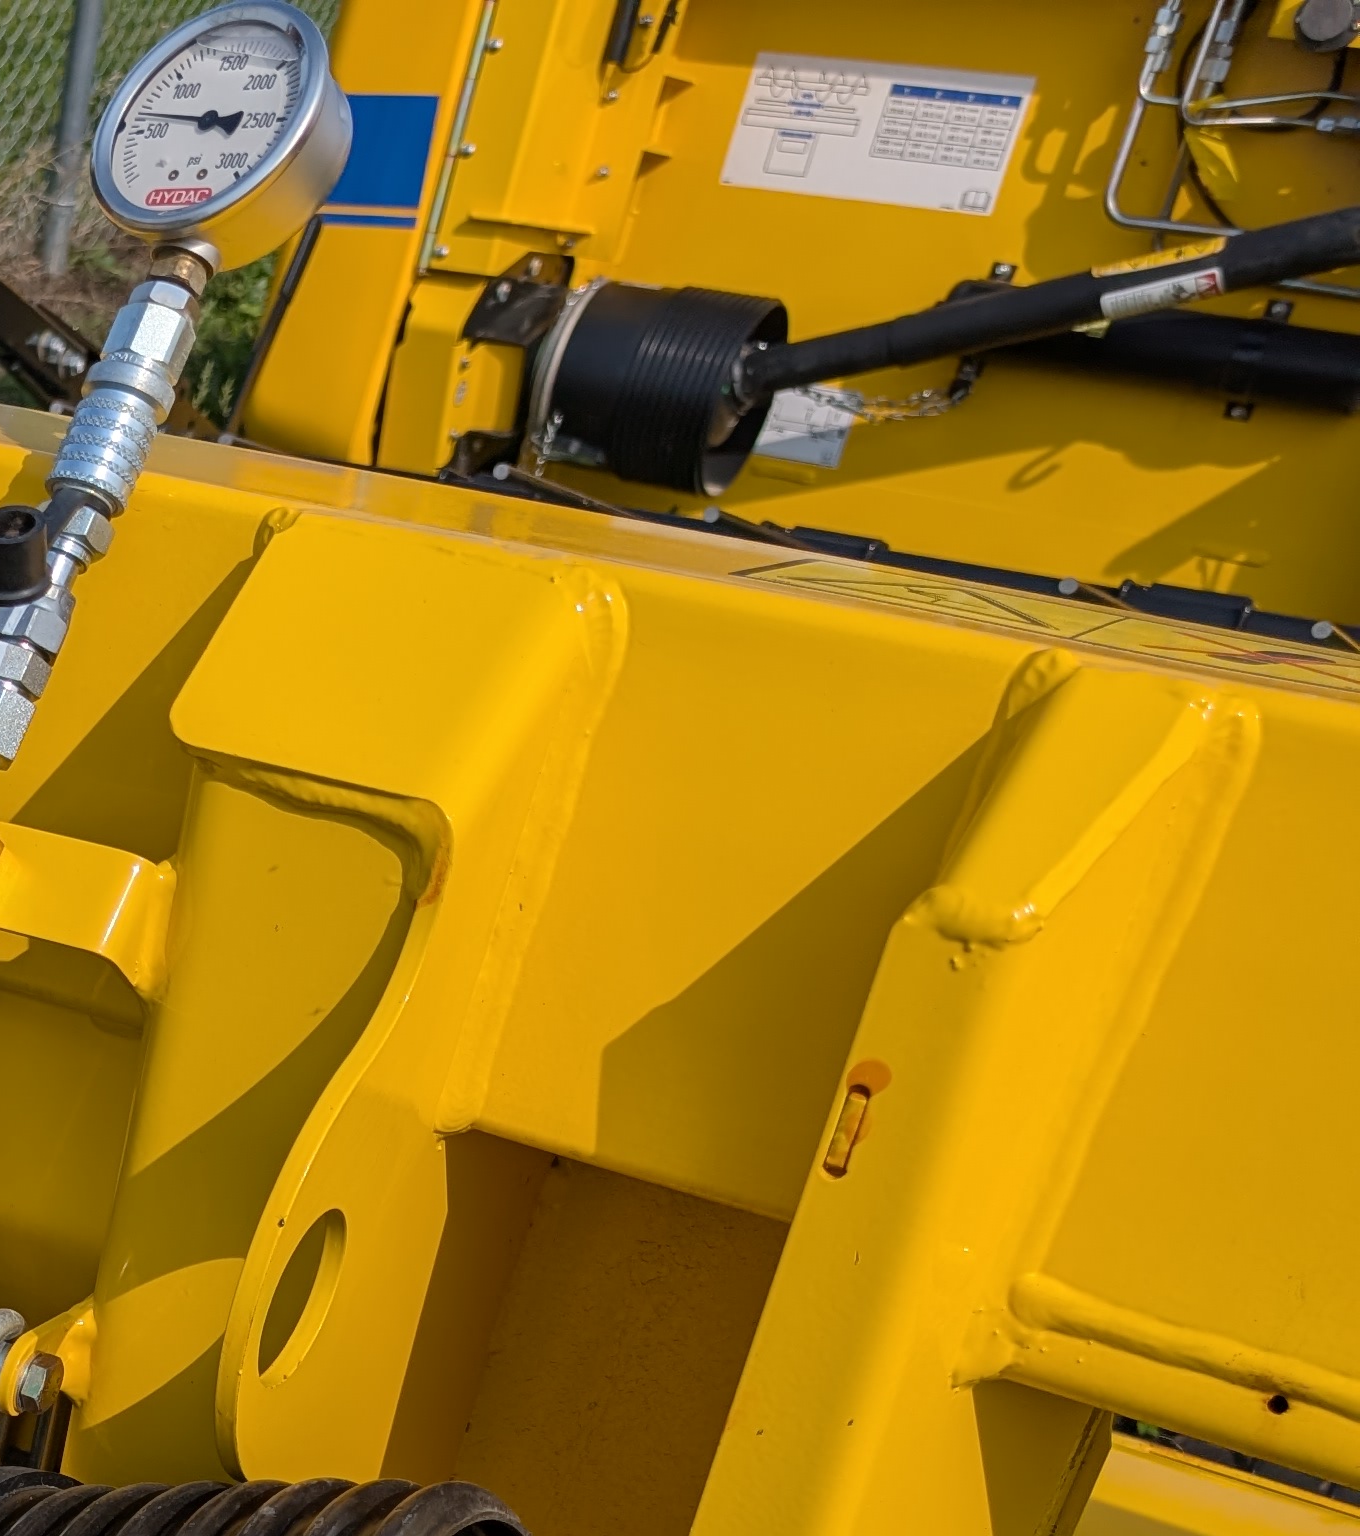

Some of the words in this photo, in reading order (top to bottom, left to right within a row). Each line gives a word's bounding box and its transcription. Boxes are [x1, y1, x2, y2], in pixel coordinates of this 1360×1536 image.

[219, 54, 248, 72] 1500
[172, 82, 202, 100] 1000
[243, 73, 278, 92] 2000
[241, 112, 277, 130] 2500
[143, 122, 169, 141] 500
[186, 154, 204, 169] psi
[215, 152, 249, 170] 3000
[149, 188, 211, 207] HYDAC
